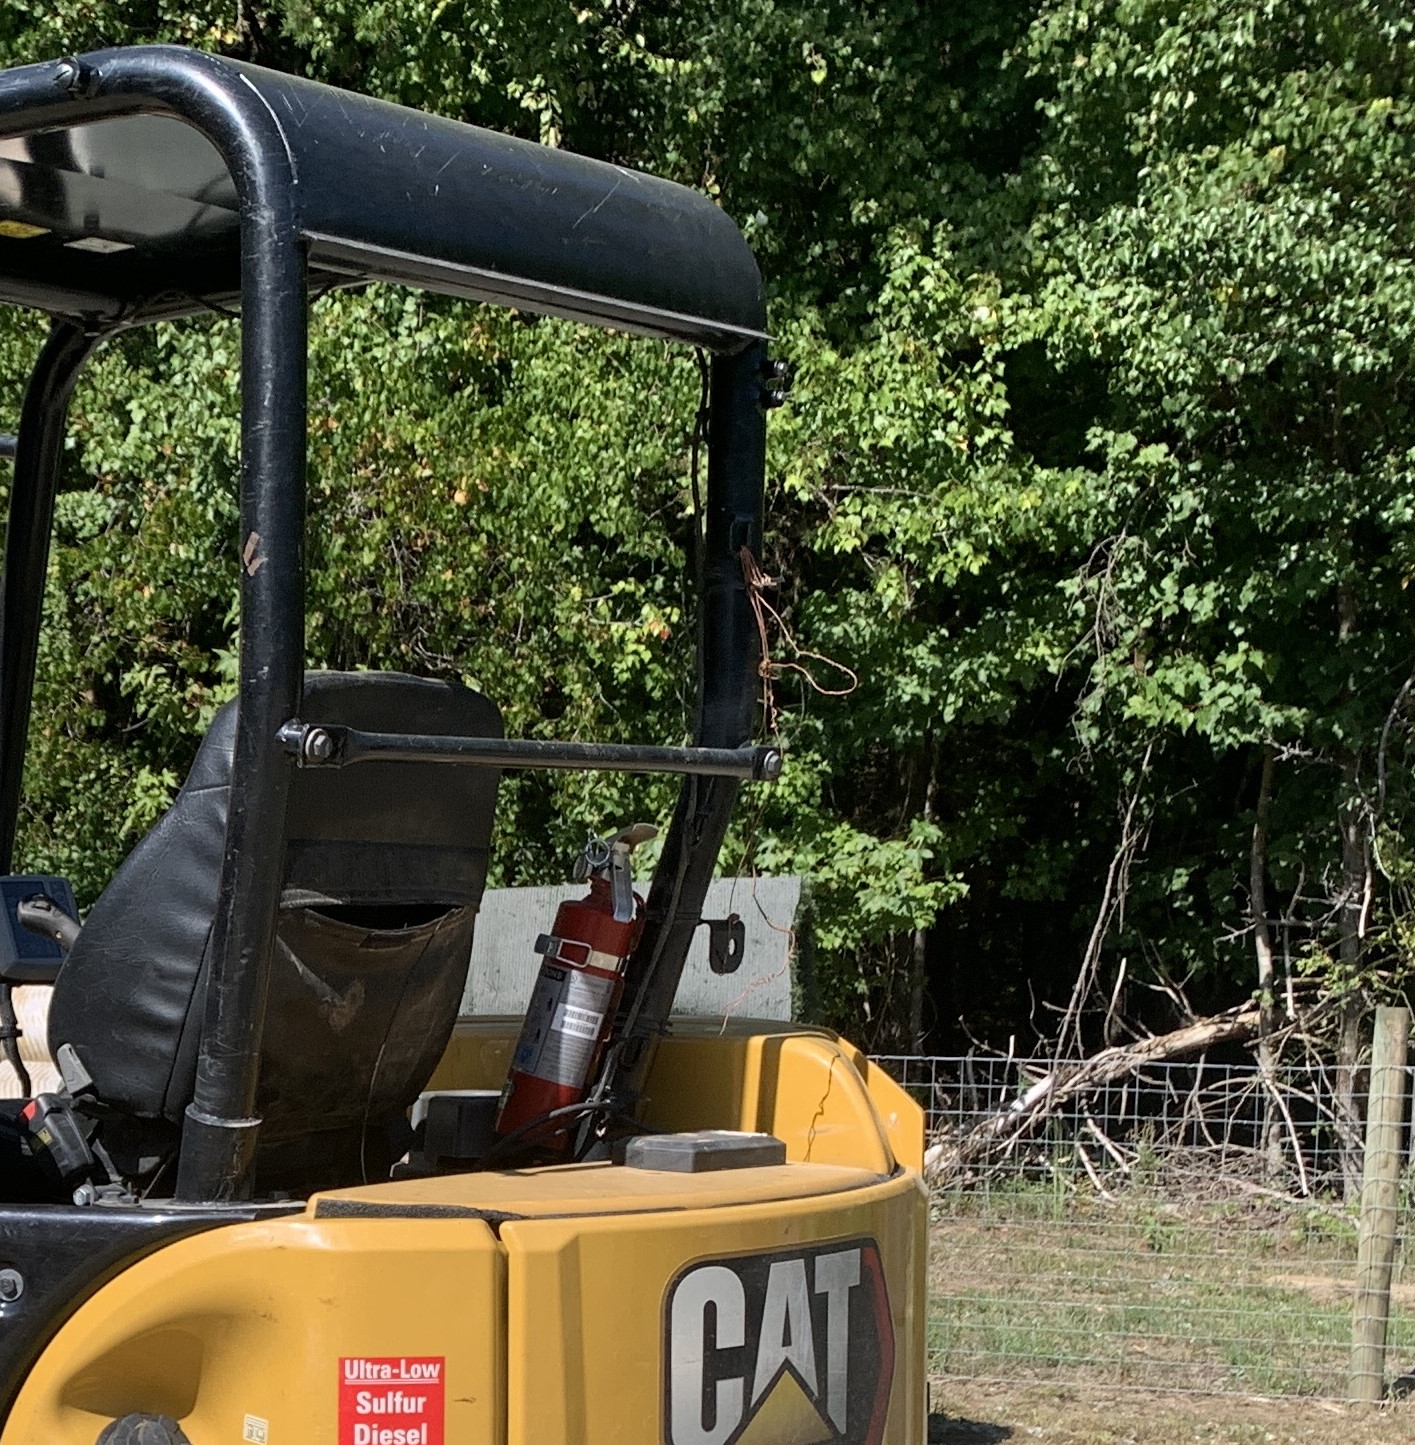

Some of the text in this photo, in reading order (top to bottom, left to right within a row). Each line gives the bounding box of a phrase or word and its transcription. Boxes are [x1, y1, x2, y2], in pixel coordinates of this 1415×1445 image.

[344, 1359, 441, 1380] Ultra-Low
[356, 1391, 427, 1414] Sulfur
[354, 1423, 428, 1445] Diesel
